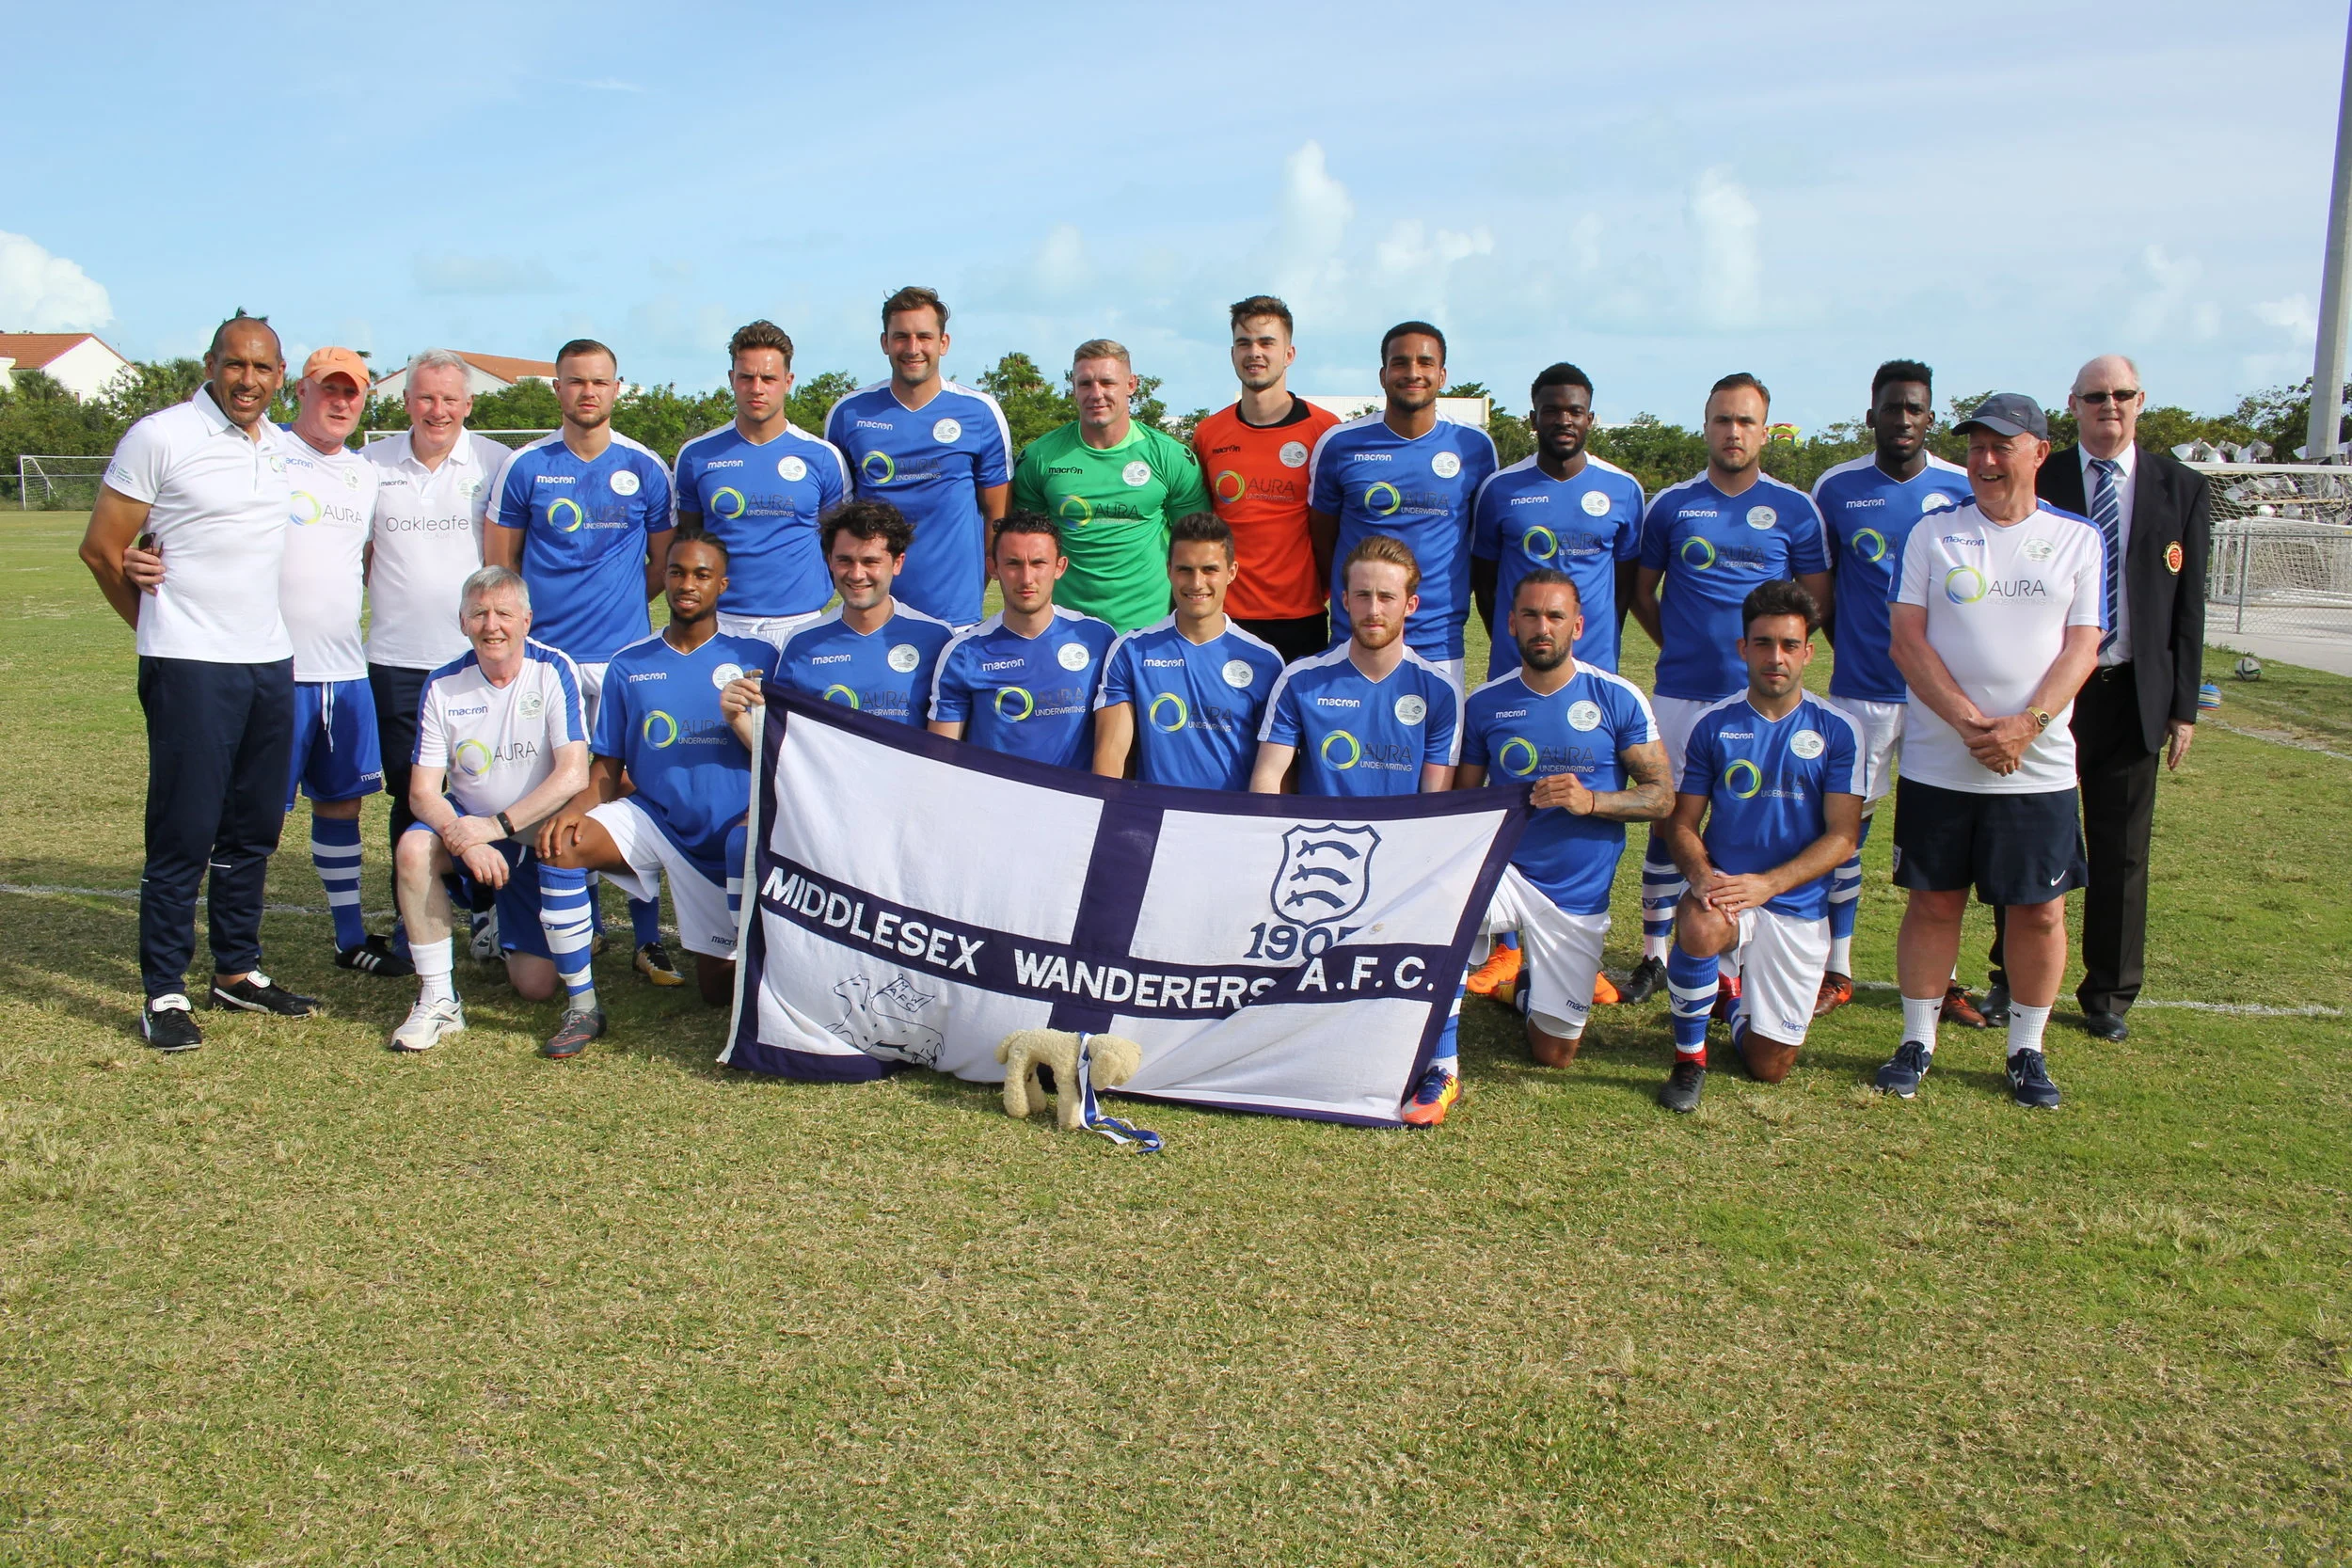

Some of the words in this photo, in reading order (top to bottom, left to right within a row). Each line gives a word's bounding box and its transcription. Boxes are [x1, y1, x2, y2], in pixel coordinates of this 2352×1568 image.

[857, 420, 893, 431] macron
[285, 457, 314, 469] acron
[1354, 452, 1392, 462] macron
[707, 459, 743, 469] macron
[1048, 466, 1083, 475] macron
[536, 474, 576, 484] macron
[1246, 478, 1295, 494] AURA
[747, 495, 796, 510] AURA
[1510, 495, 1549, 506] macron
[1846, 498, 1885, 508] macron
[323, 504, 364, 527] AURA
[1094, 503, 1140, 518] AURA
[1678, 509, 1718, 518] macron
[386, 515, 469, 532] Oakleafe
[1943, 534, 1985, 547] macron
[1987, 579, 2046, 597] AURA
[812, 654, 851, 665] macron
[982, 658, 1025, 672] macron
[1144, 658, 1184, 667] macron
[629, 672, 667, 683] macron
[861, 690, 912, 708] AURA
[1317, 697, 1360, 708] macron
[448, 705, 488, 718] macron
[1035, 705, 1086, 717] UNDERWRITING
[1495, 708, 1527, 720] macron
[1720, 731, 1755, 739] macron
[493, 740, 538, 763] AURA
[1361, 743, 1413, 763] AURA
[1539, 746, 1596, 765] AURA
[1359, 761, 1412, 772] UNDERWRITING
[1539, 765, 1596, 773] UNDERWRITING
[760, 865, 986, 976] MIDDLESEX
